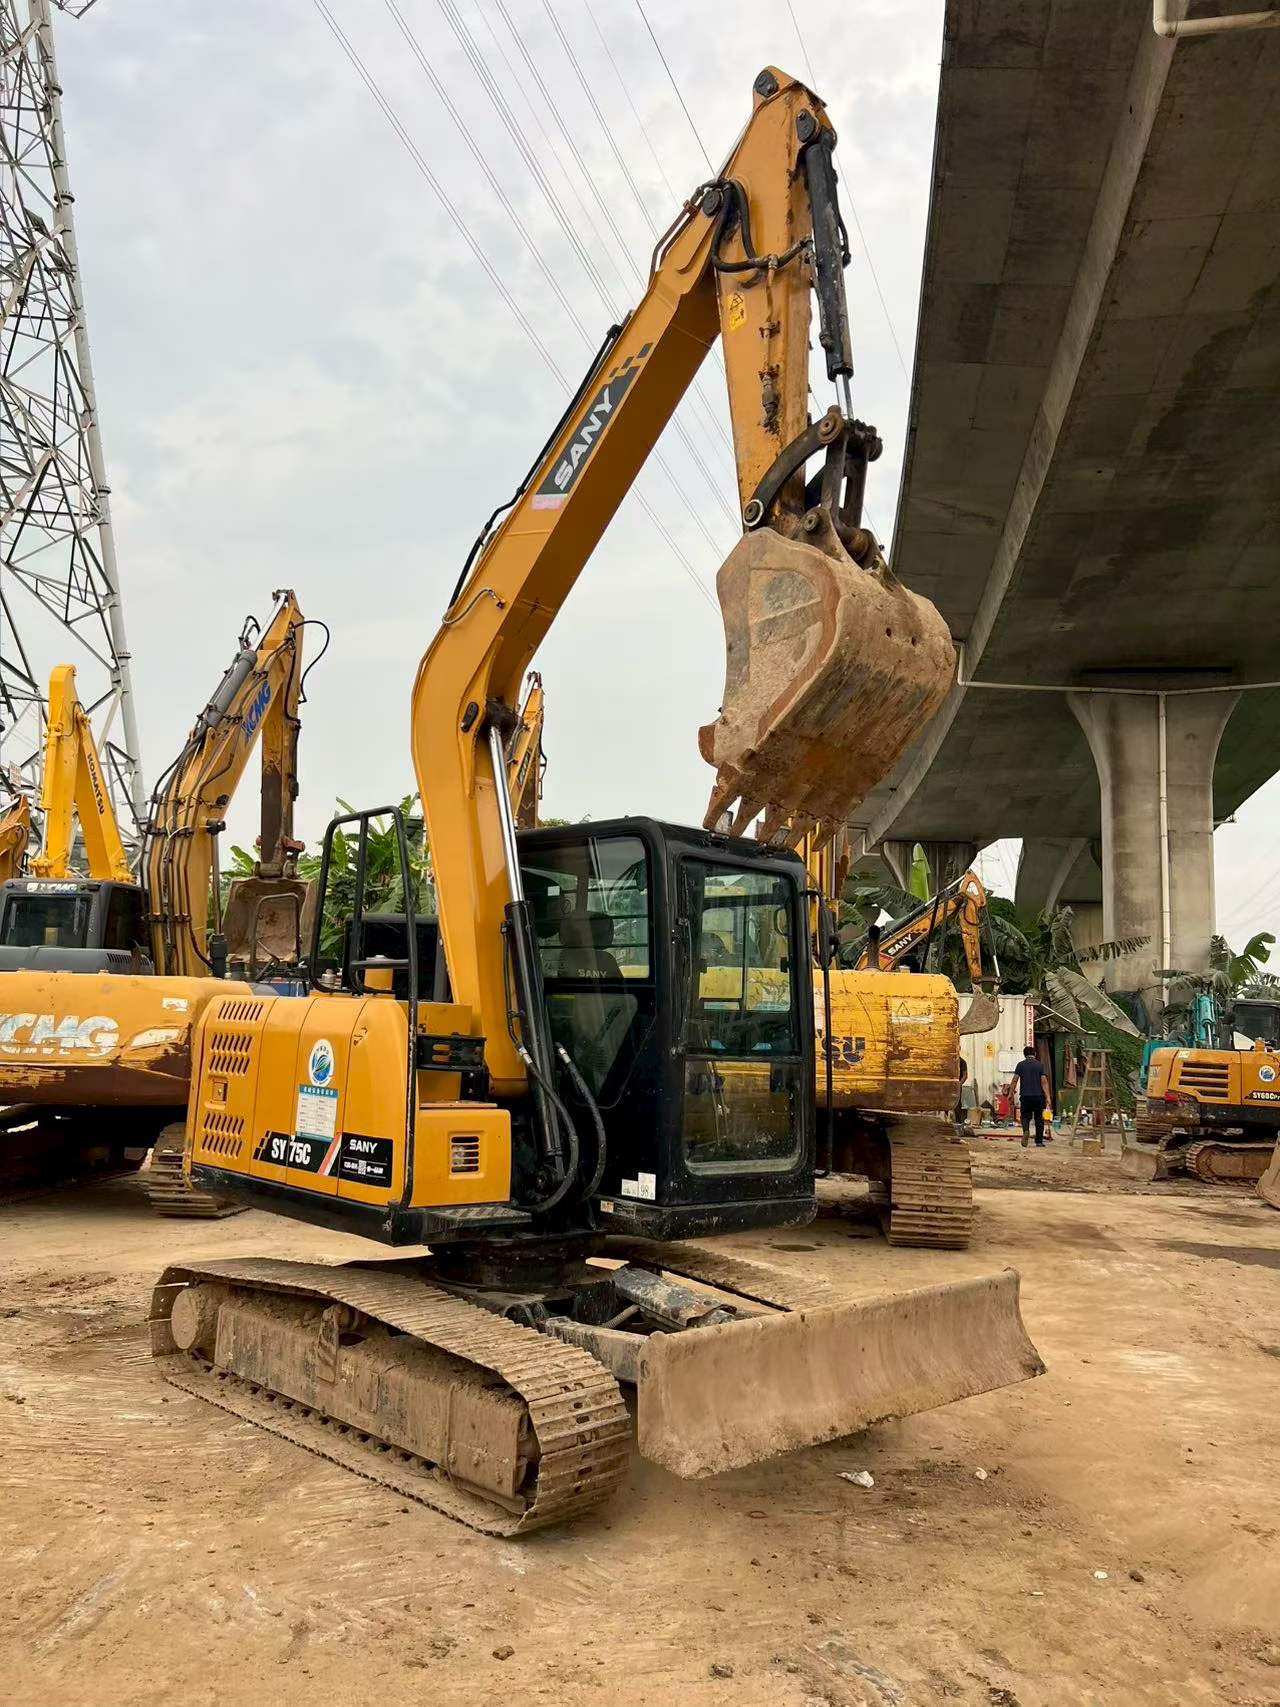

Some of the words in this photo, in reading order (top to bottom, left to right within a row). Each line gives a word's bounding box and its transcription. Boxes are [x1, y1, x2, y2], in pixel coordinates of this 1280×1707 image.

[554, 386, 613, 491] SANY
[87, 753, 105, 815] KOMATSU
[888, 934, 912, 955] SANY
[578, 969, 607, 978] SANY
[349, 1139, 378, 1153] SANY
